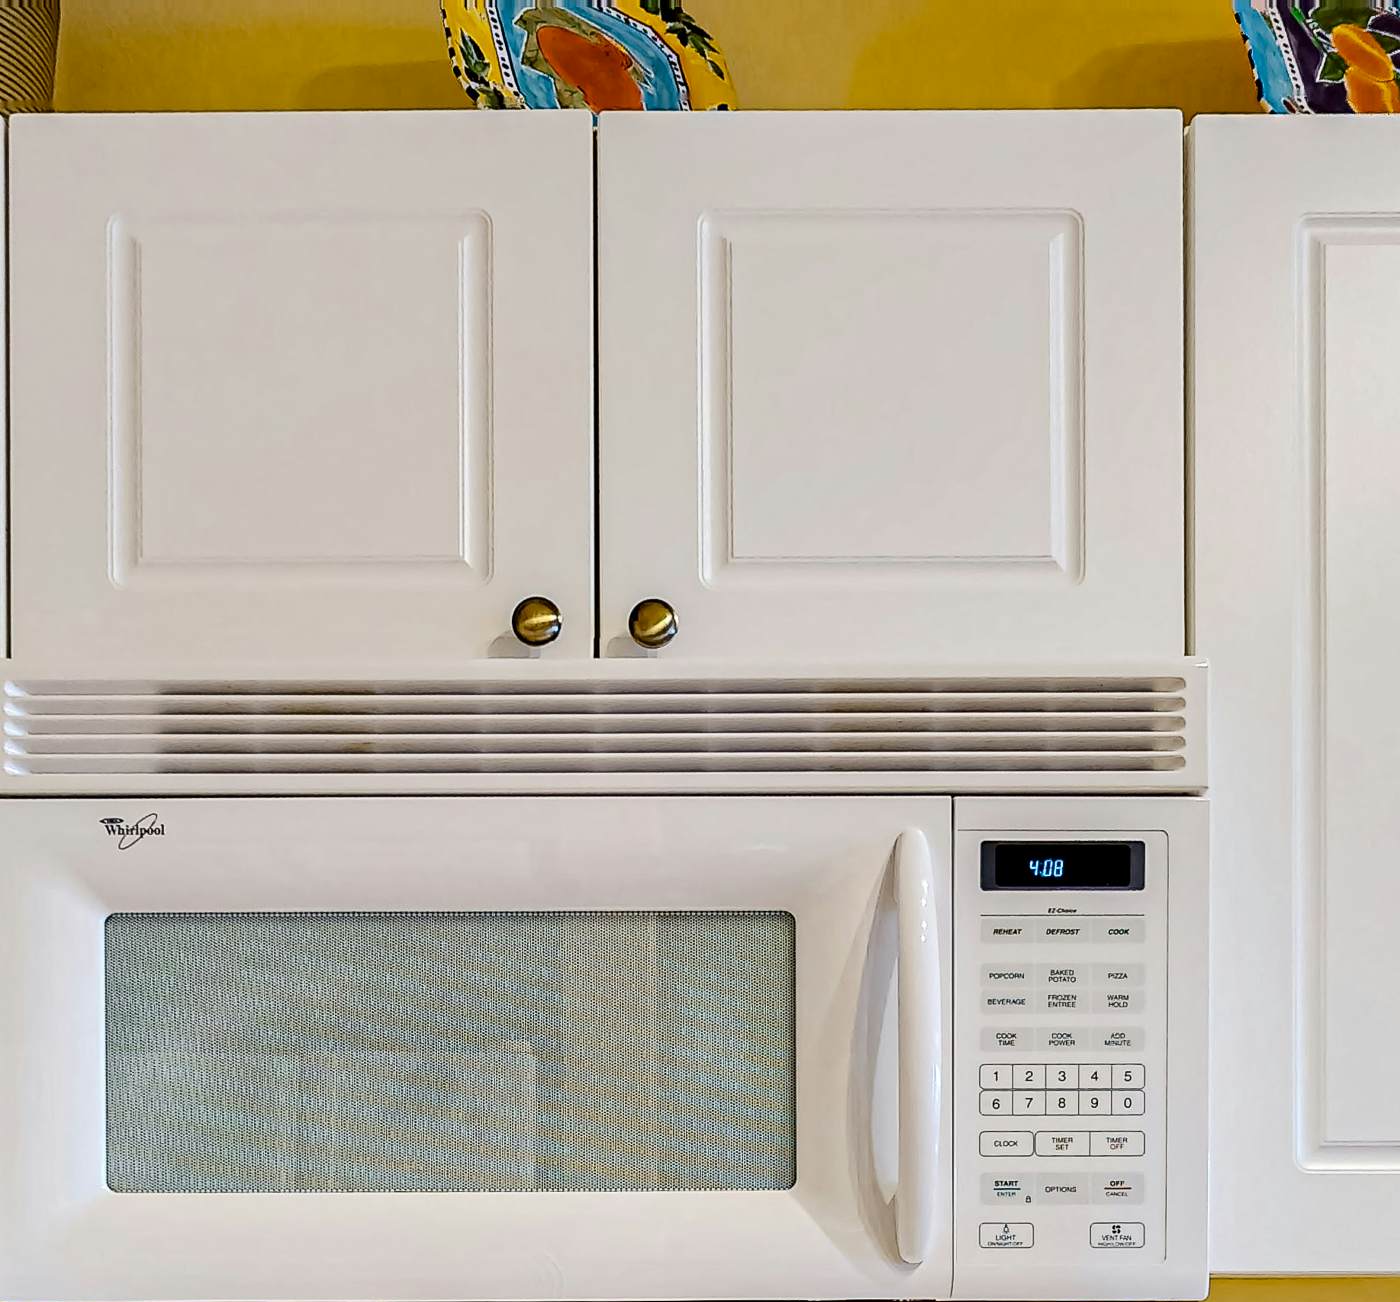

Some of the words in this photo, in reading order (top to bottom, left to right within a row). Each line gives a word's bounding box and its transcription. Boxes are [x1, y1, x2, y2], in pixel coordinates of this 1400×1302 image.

[104, 824, 165, 838] Whirlpool
[993, 1071, 998, 1081] 1
[1025, 1071, 1033, 1081] 2
[1058, 1071, 1066, 1082] 3
[1090, 1071, 1098, 1081] 4
[1123, 1071, 1132, 1082] 5
[992, 1099, 1000, 1109] 6
[1025, 1098, 1033, 1108] 7
[1058, 1098, 1066, 1108] 8
[1090, 1098, 1098, 1108] 9
[1123, 1098, 1132, 1108] 0
